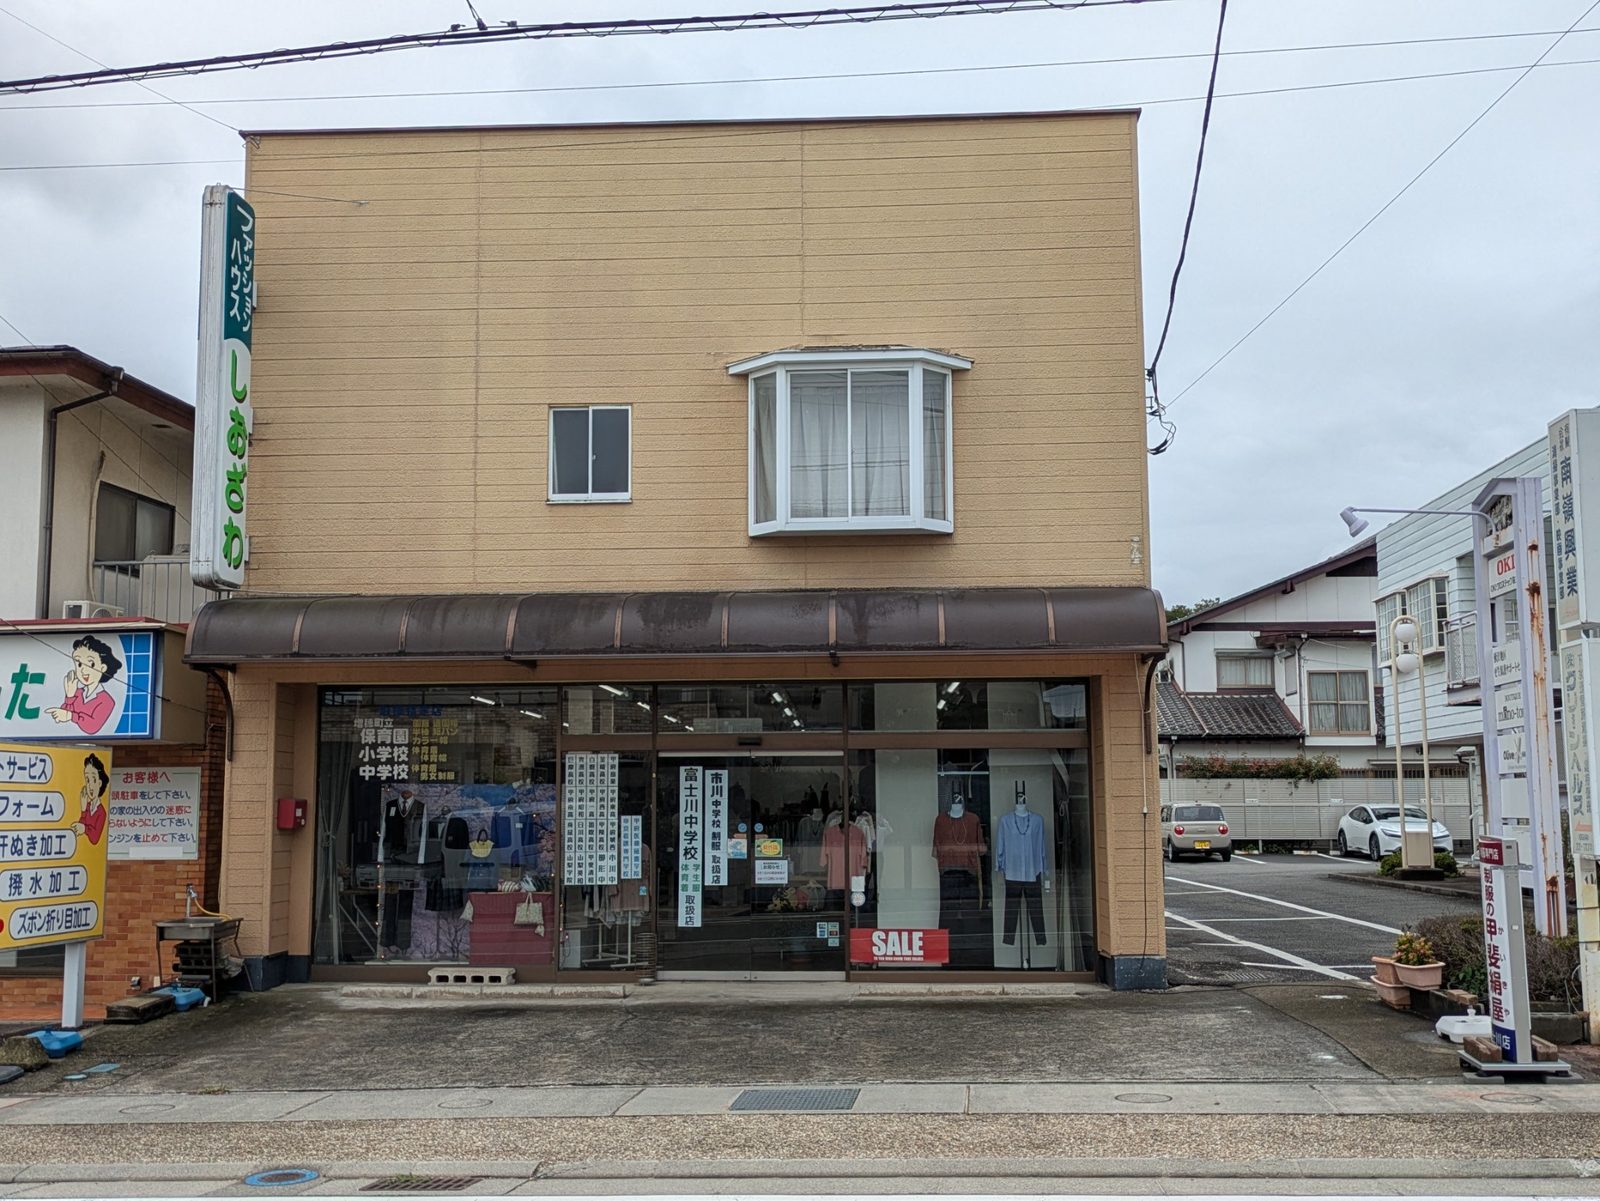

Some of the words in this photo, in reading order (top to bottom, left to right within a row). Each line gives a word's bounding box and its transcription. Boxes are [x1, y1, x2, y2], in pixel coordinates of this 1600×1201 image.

[229, 238, 242, 322] ハウス
[236, 205, 253, 332] ファッション
[1496, 554, 1516, 576] OKI
[0, 663, 46, 721] た
[360, 728, 409, 745] 保育園
[359, 746, 409, 762] 小学校
[122, 771, 171, 784] お客様へ
[359, 763, 409, 780] 中学校
[683, 767, 699, 861] 富士川中学校
[710, 772, 723, 829] 市川中学校
[692, 863, 700, 892] 学生服
[711, 855, 721, 884] 取扱店
[17, 906, 91, 935] ズボン折り目加工
[684, 894, 695, 926] 取扱店
[872, 930, 924, 956] SALE
